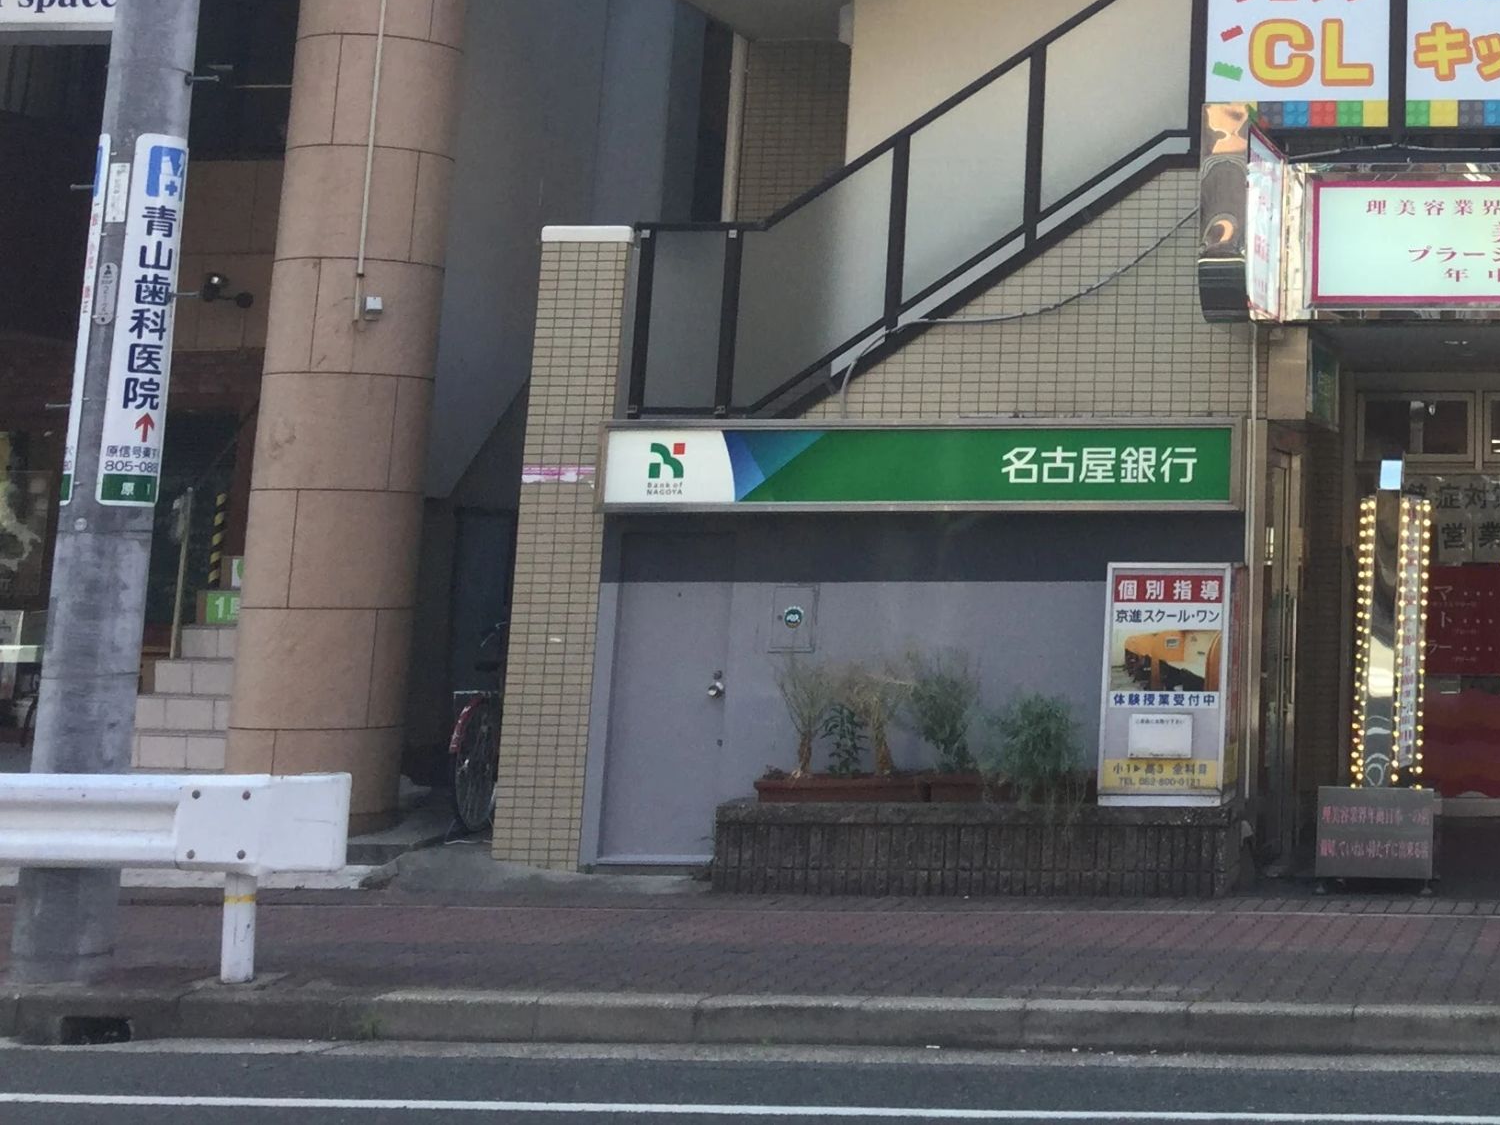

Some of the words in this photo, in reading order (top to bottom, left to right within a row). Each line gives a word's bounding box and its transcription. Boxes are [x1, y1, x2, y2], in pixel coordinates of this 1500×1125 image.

[122, 204, 178, 412] 青山歯科医院
[1000, 446, 1199, 485] 名古屋銀行
[1118, 579, 1221, 600] 個別指導
[1115, 609, 1221, 624] 京進スクール・ワン
[1113, 693, 1216, 708] 体験授業受付中
